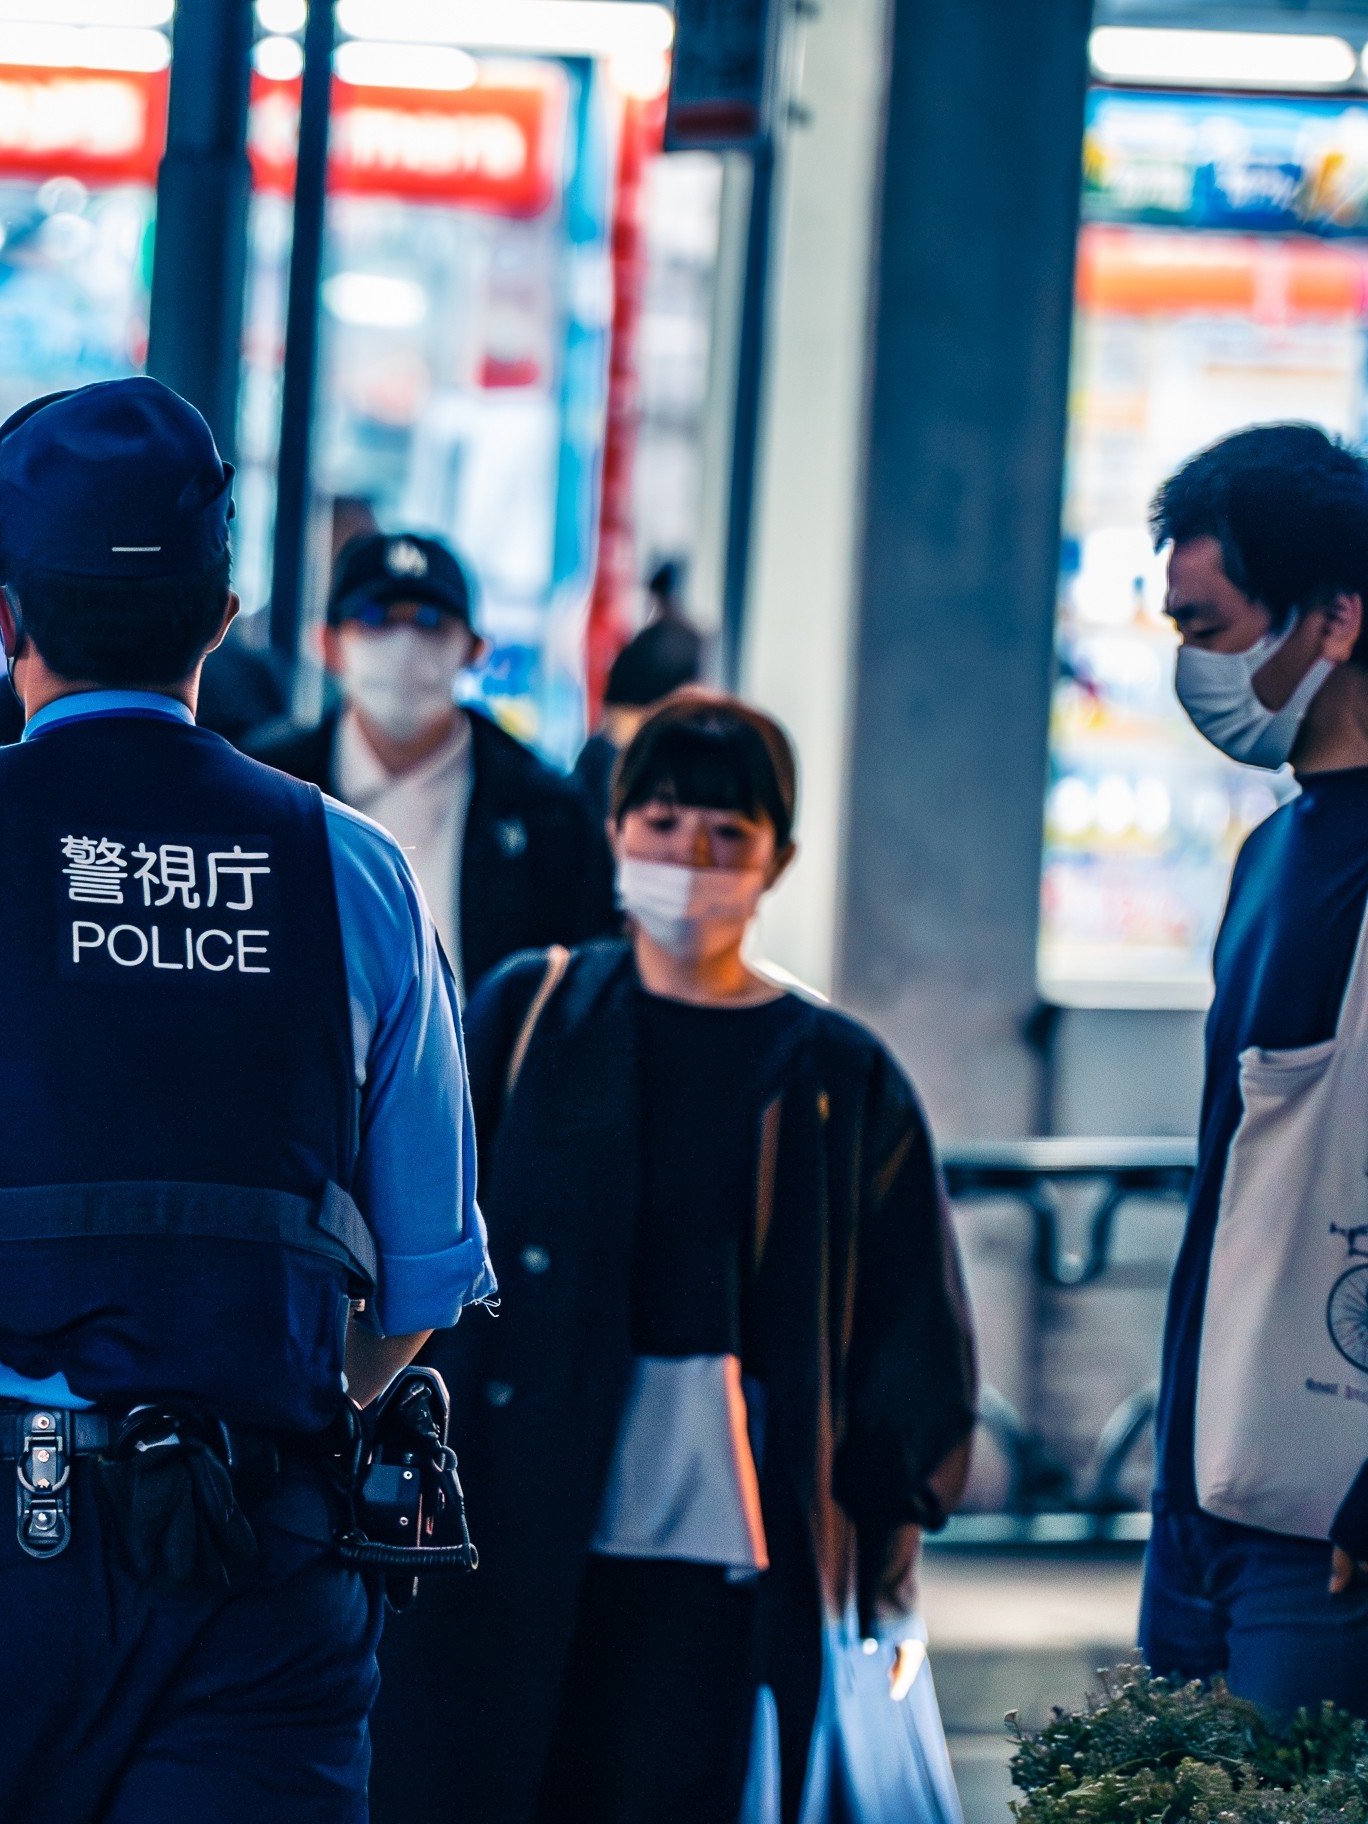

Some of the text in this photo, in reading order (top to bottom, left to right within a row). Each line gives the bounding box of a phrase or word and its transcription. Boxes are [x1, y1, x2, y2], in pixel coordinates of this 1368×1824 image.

[60, 834, 271, 911] 警視庁
[72, 920, 271, 973] POLICE
